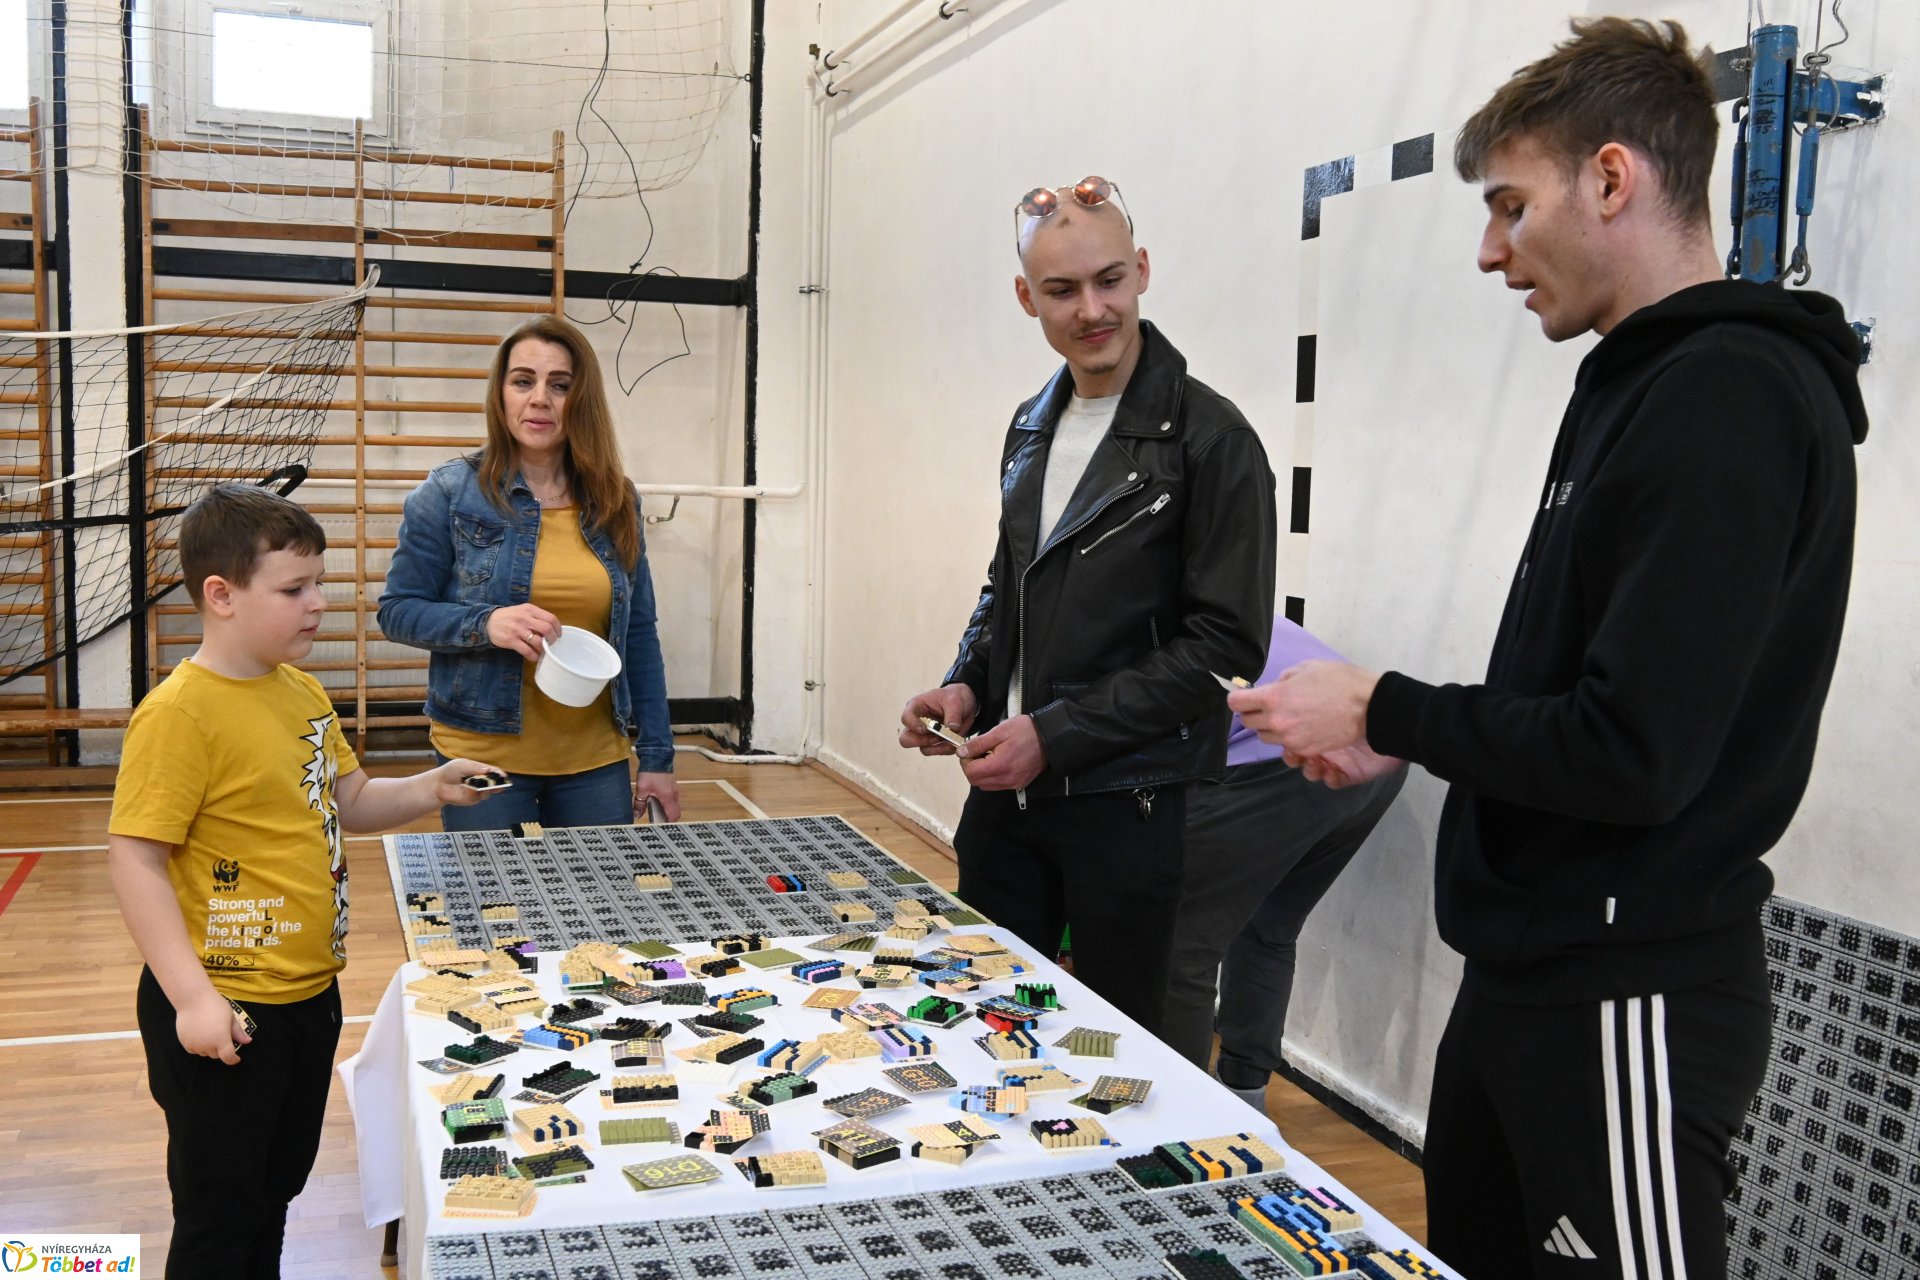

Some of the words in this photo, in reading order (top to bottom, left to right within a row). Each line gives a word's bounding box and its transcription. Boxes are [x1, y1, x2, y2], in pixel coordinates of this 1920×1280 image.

[213, 885, 239, 893] WWF
[208, 898, 255, 911] Strong
[258, 896, 284, 908] and
[207, 925, 229, 937] the
[232, 925, 261, 938] king
[264, 922, 278, 934] of
[280, 921, 302, 933] the
[205, 938, 241, 950] pride
[244, 935, 282, 948] lands.
[206, 955, 240, 966] 40%
[832, 1128, 876, 1147] A11
[645, 1159, 701, 1179] D16
